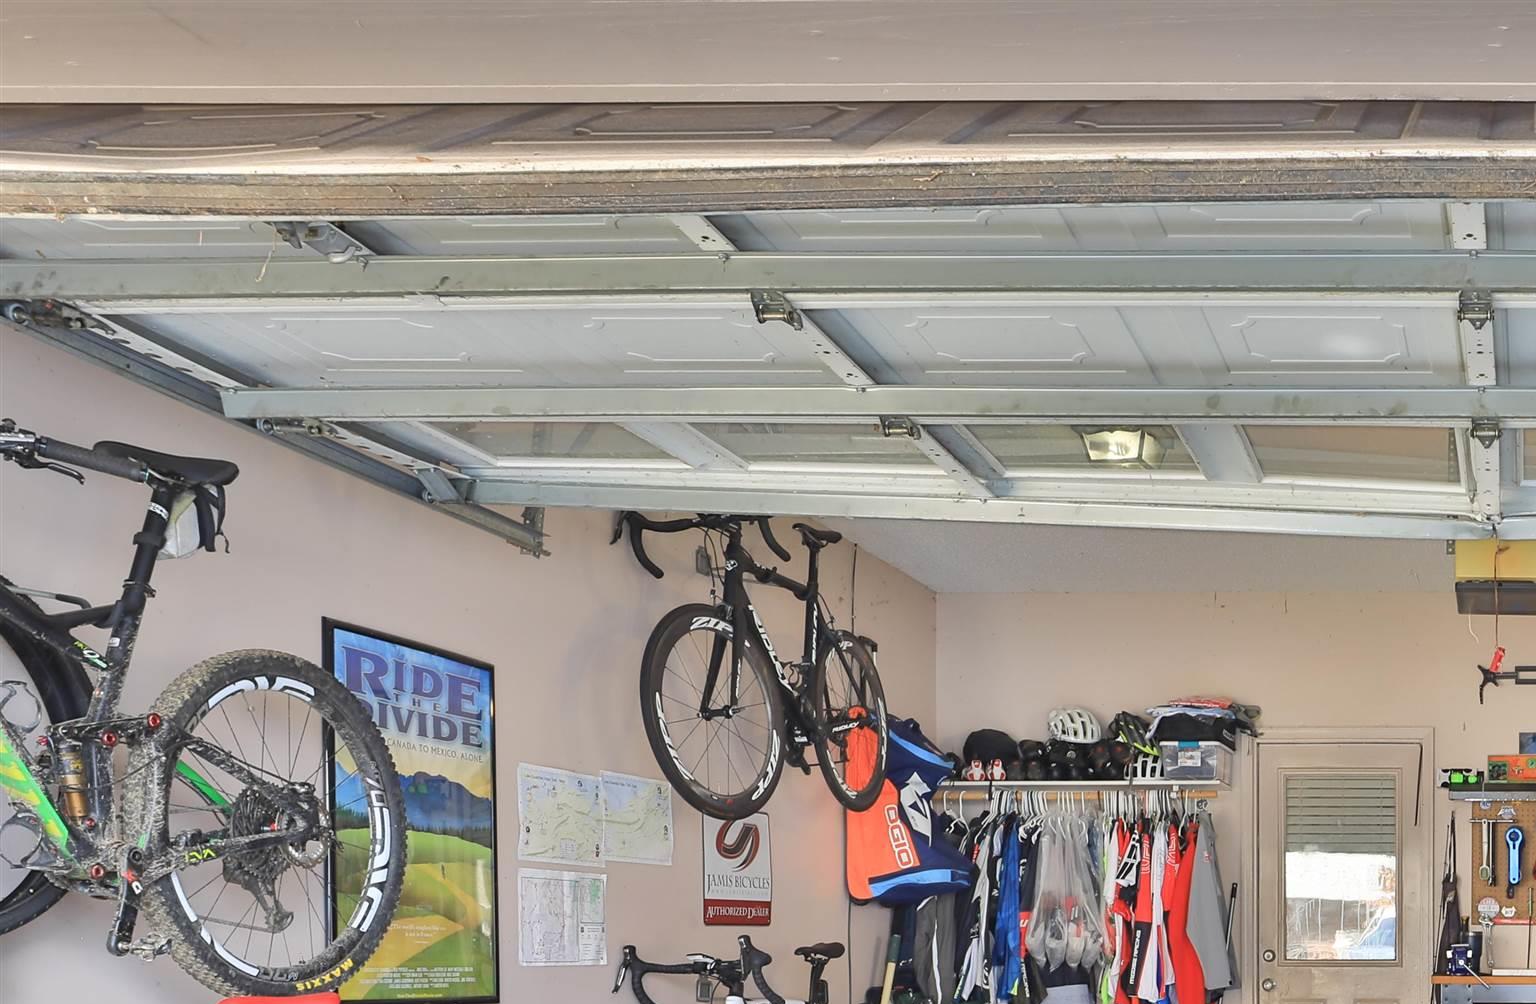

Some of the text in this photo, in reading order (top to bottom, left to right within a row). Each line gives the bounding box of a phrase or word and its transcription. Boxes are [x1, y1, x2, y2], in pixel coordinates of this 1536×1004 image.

[341, 646, 483, 722] RIDE
[392, 691, 442, 713] THE
[387, 737, 417, 753] CANADA
[419, 743, 430, 753] TO
[707, 873, 733, 895] JAMIS
[734, 875, 770, 890] BICYCLES
[706, 905, 769, 919] AUTHORIZED DEALER
[295, 957, 354, 992] MAXXIS
